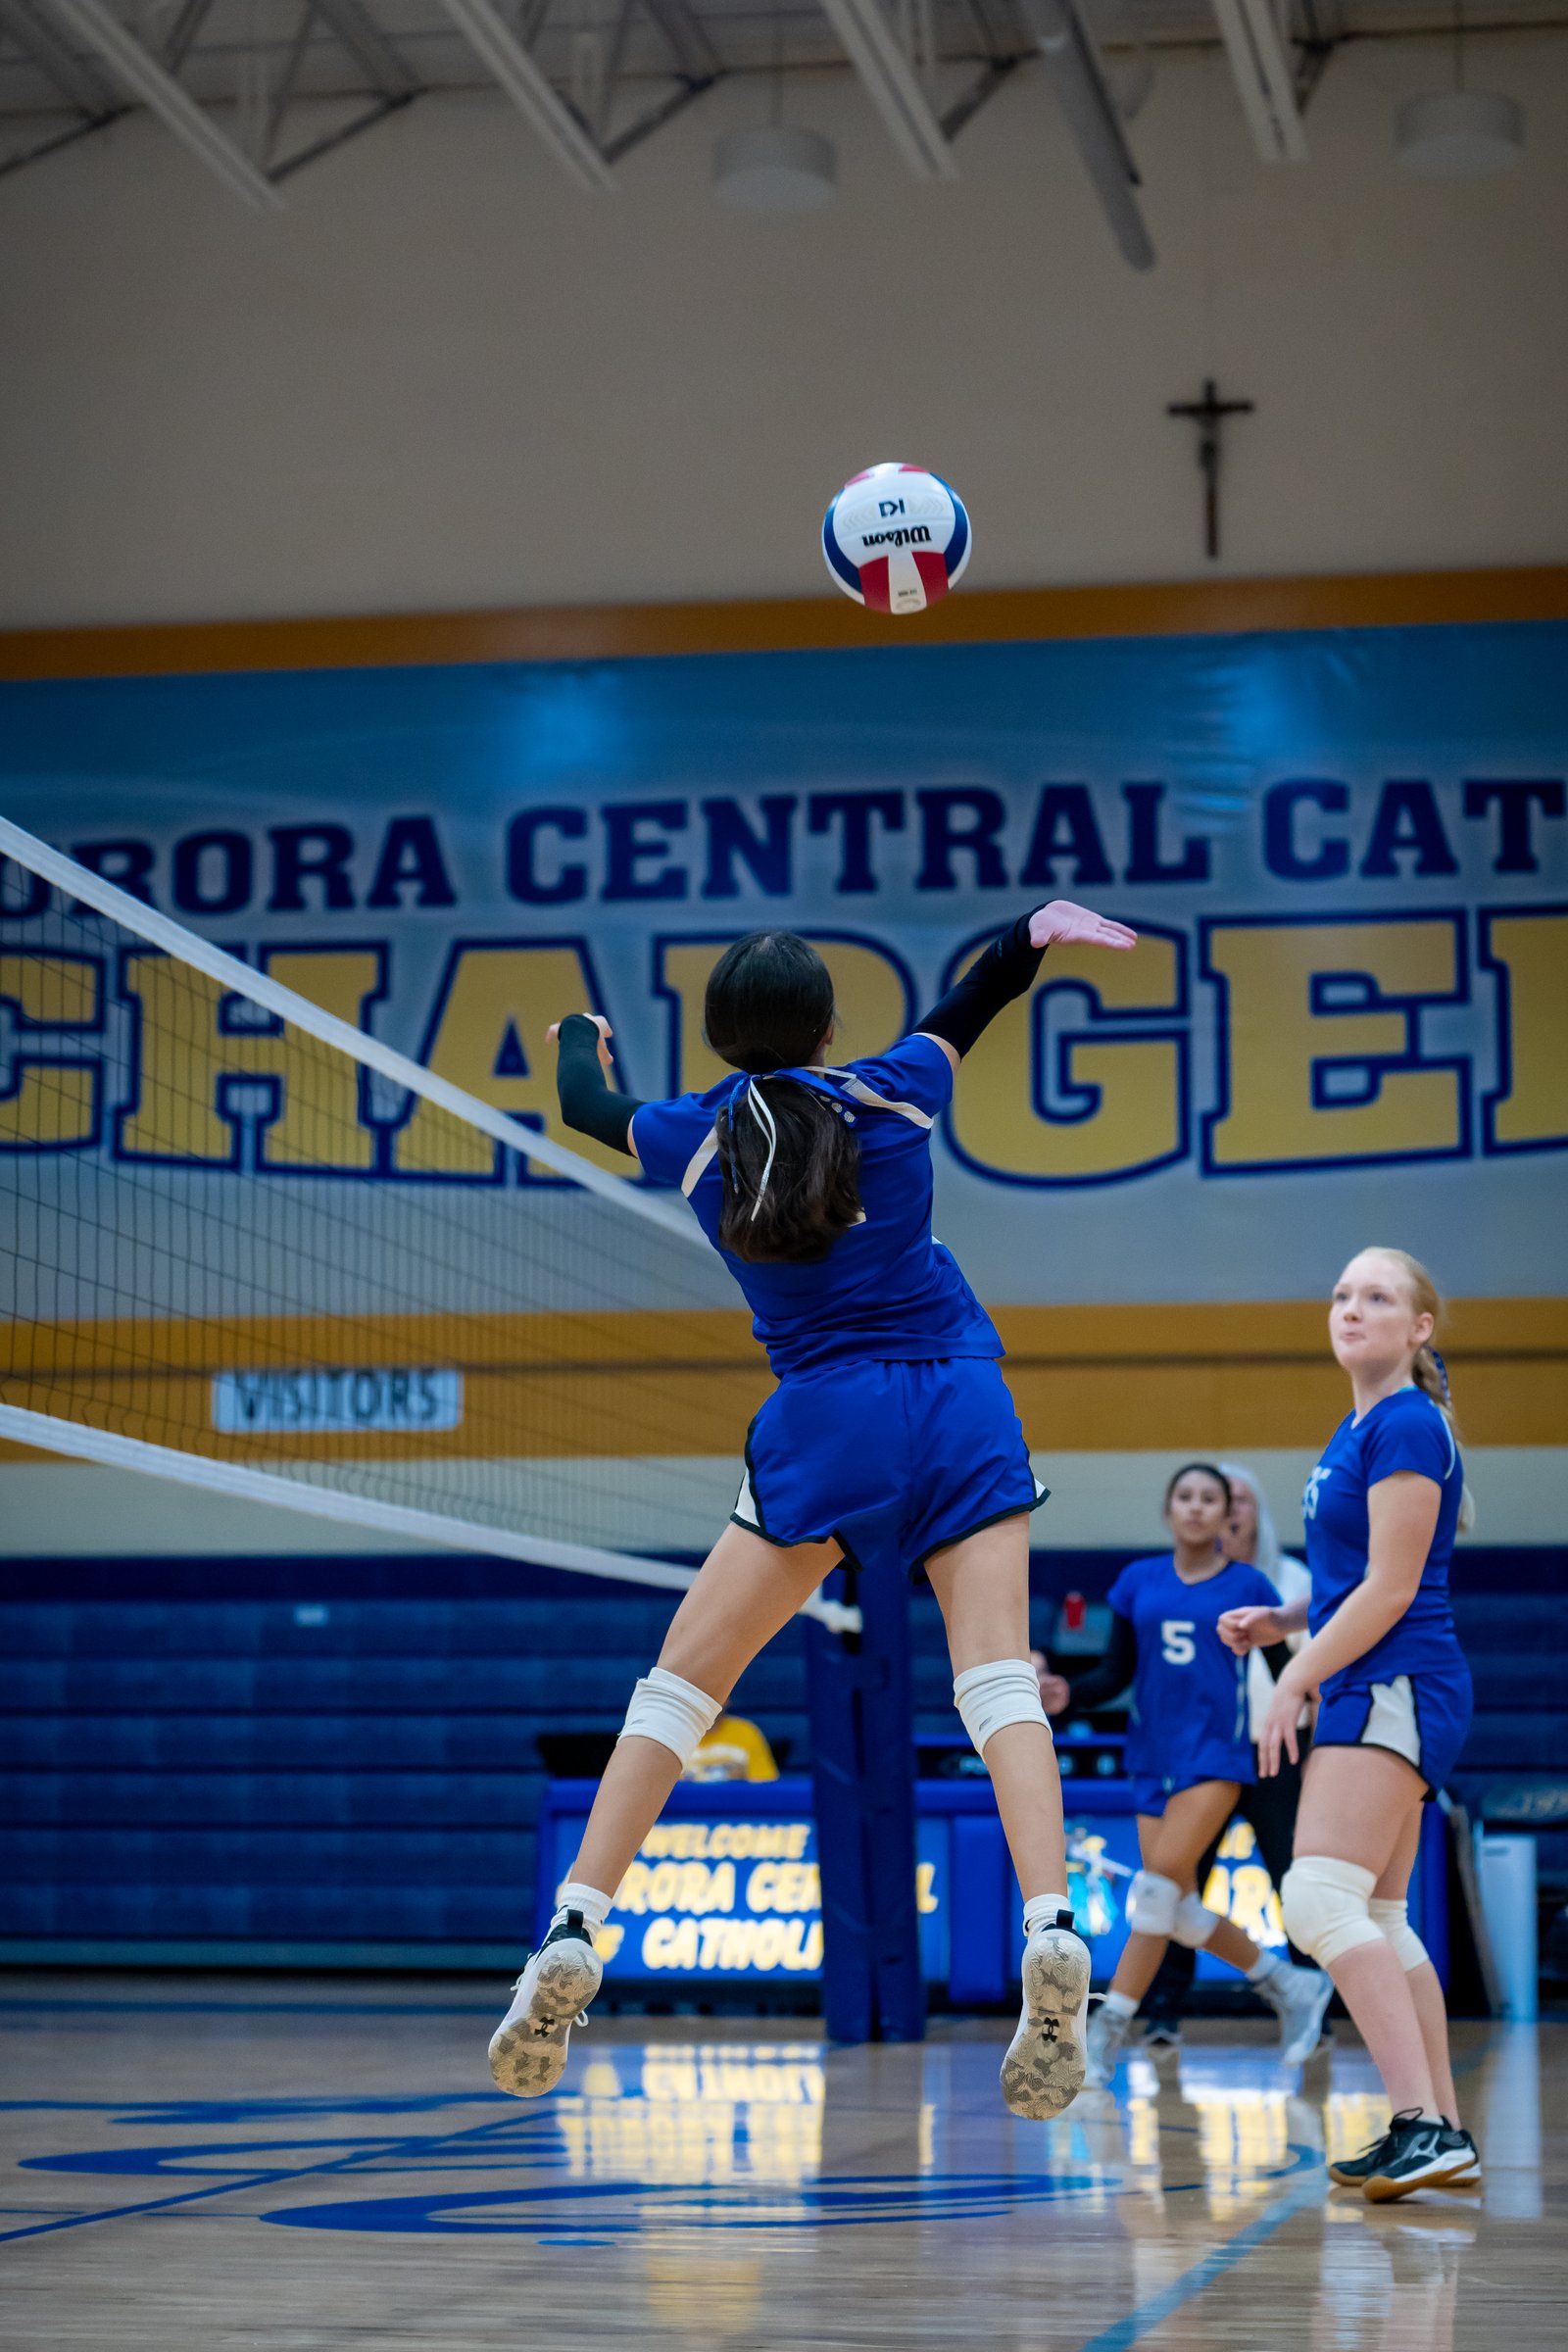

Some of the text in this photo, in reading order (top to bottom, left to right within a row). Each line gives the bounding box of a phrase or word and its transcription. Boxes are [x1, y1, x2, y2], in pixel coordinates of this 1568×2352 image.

[861, 525, 932, 548] Wilson
[507, 781, 1211, 905] CENTRAL
[233, 1369, 438, 1421] VISITORS
[1161, 1620, 1196, 1665] 5
[641, 1824, 811, 1858] WELCOME
